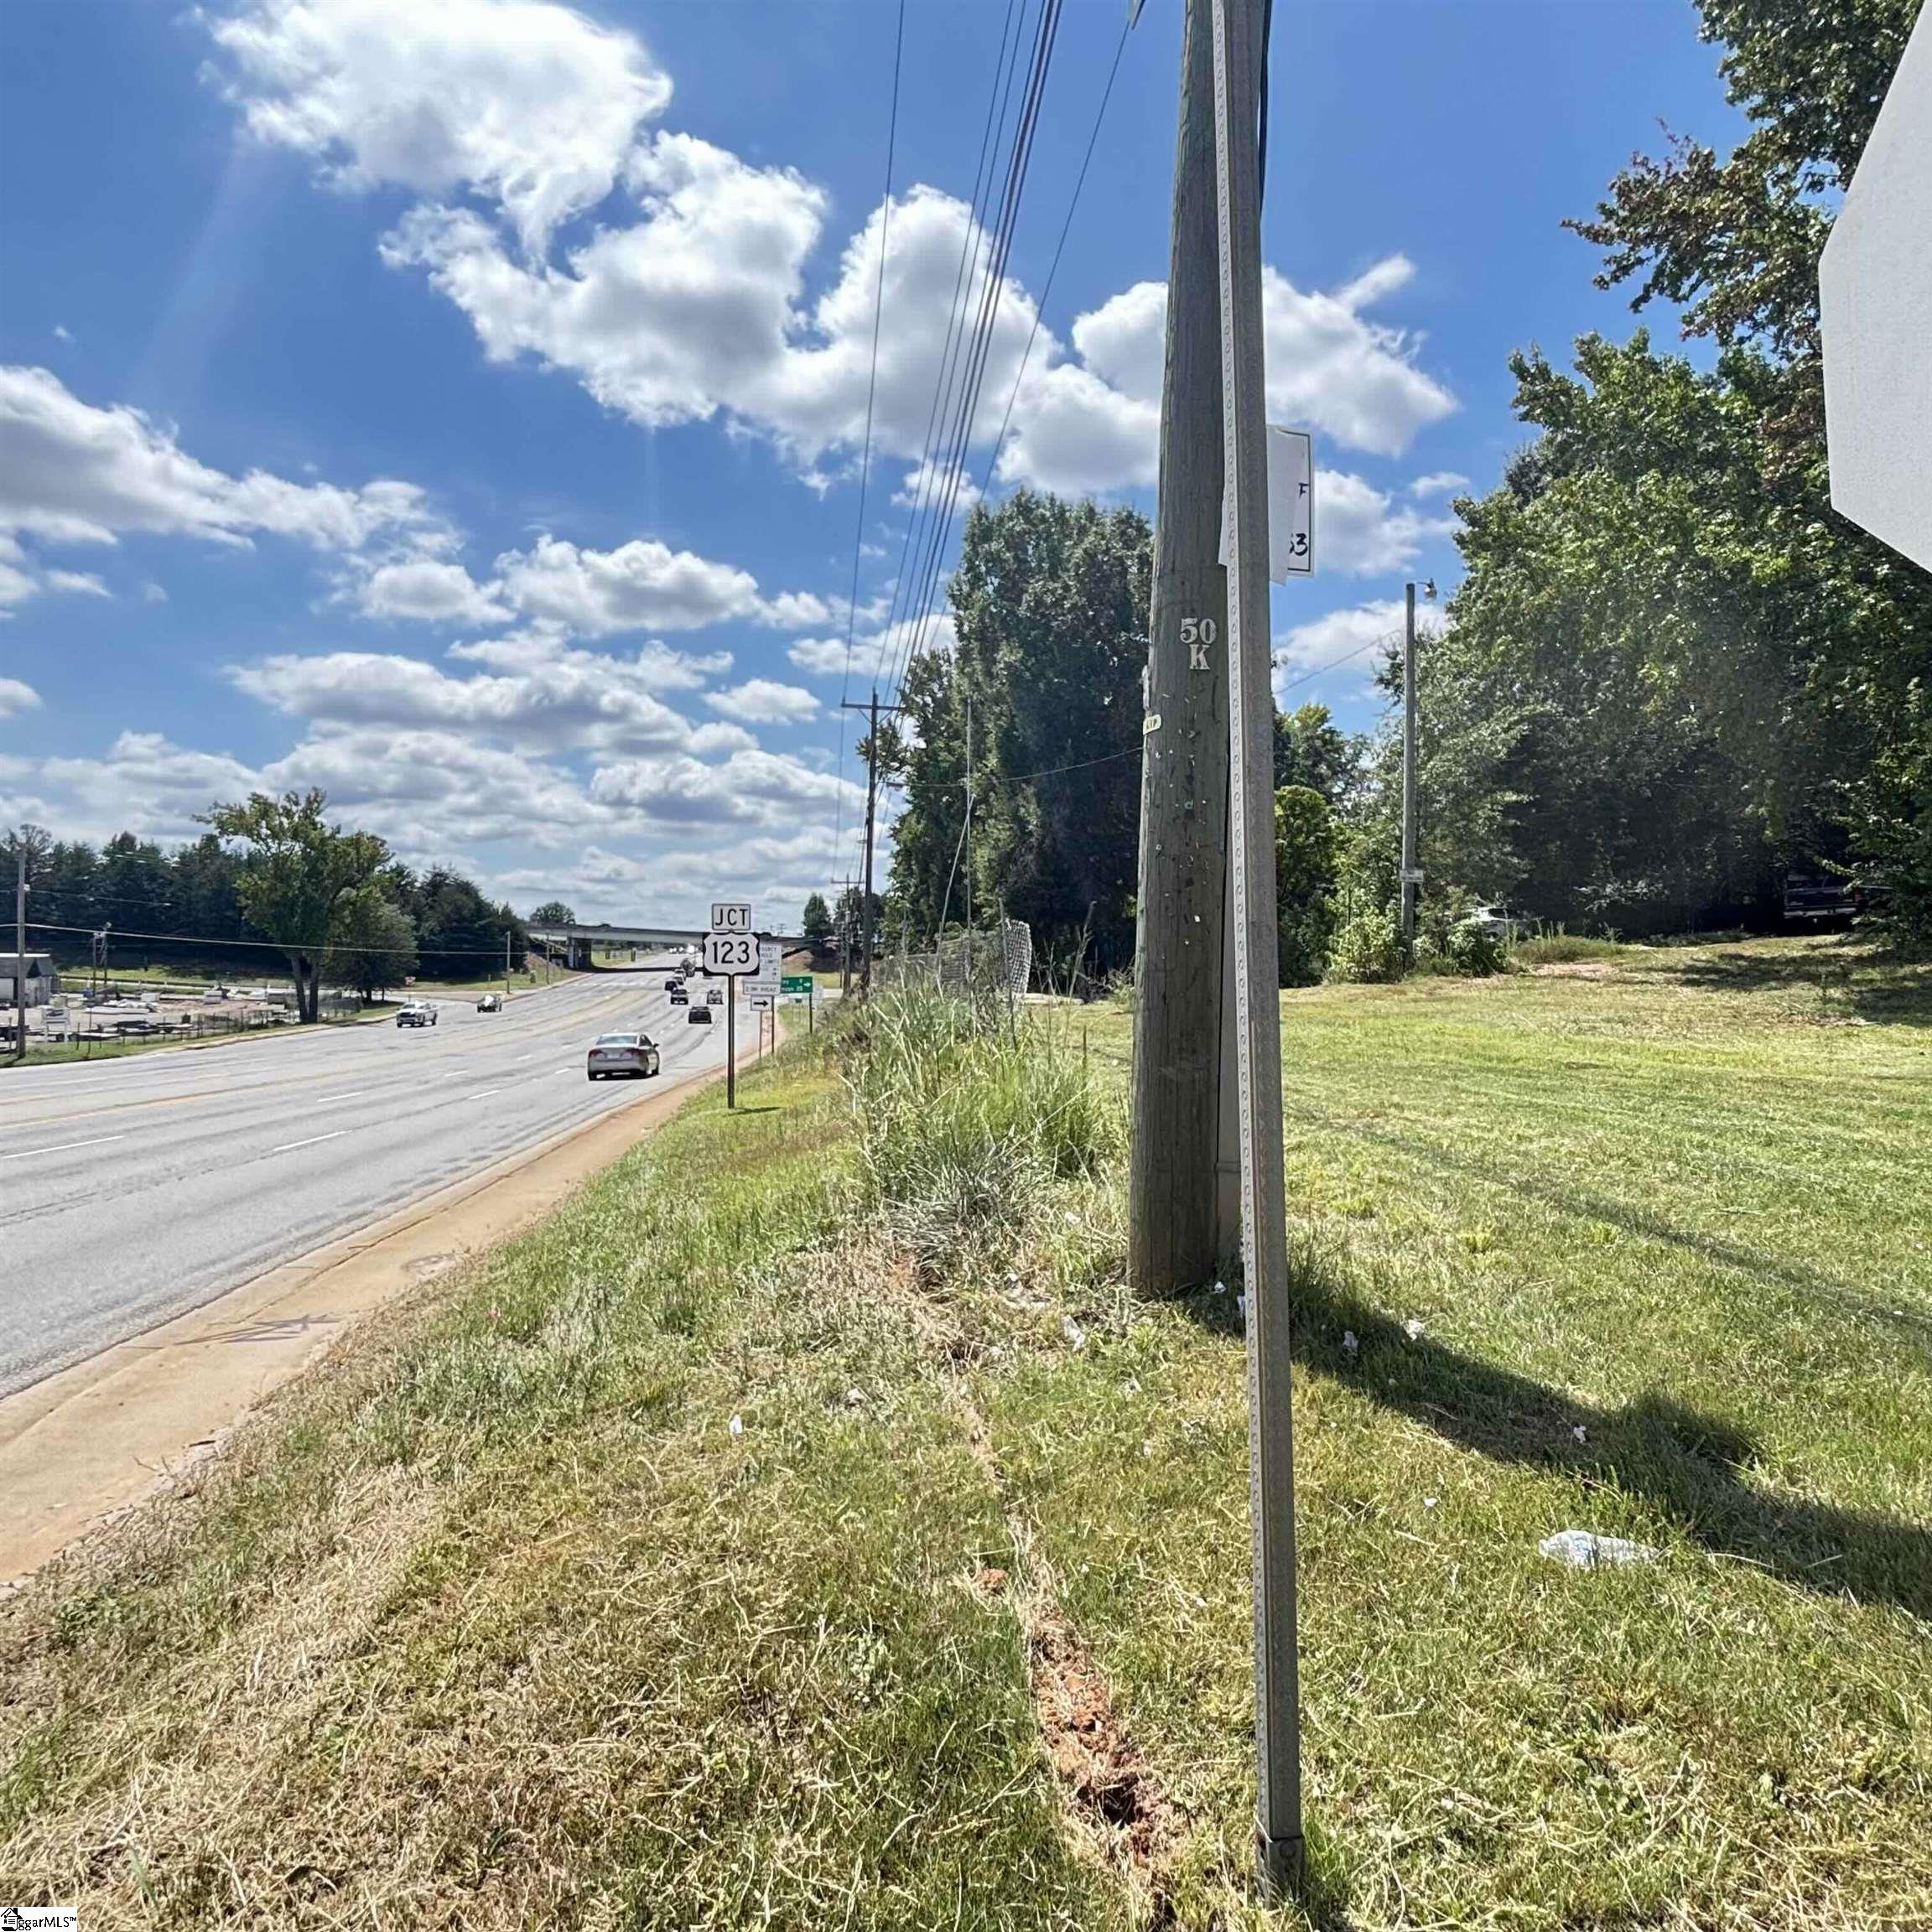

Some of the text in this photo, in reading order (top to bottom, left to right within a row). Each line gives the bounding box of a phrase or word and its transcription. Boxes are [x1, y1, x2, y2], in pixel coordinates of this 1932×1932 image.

[1180, 617, 1217, 644] 50
[1189, 644, 1211, 670] K
[715, 908, 748, 926] JCT
[712, 941, 750, 964] 123
